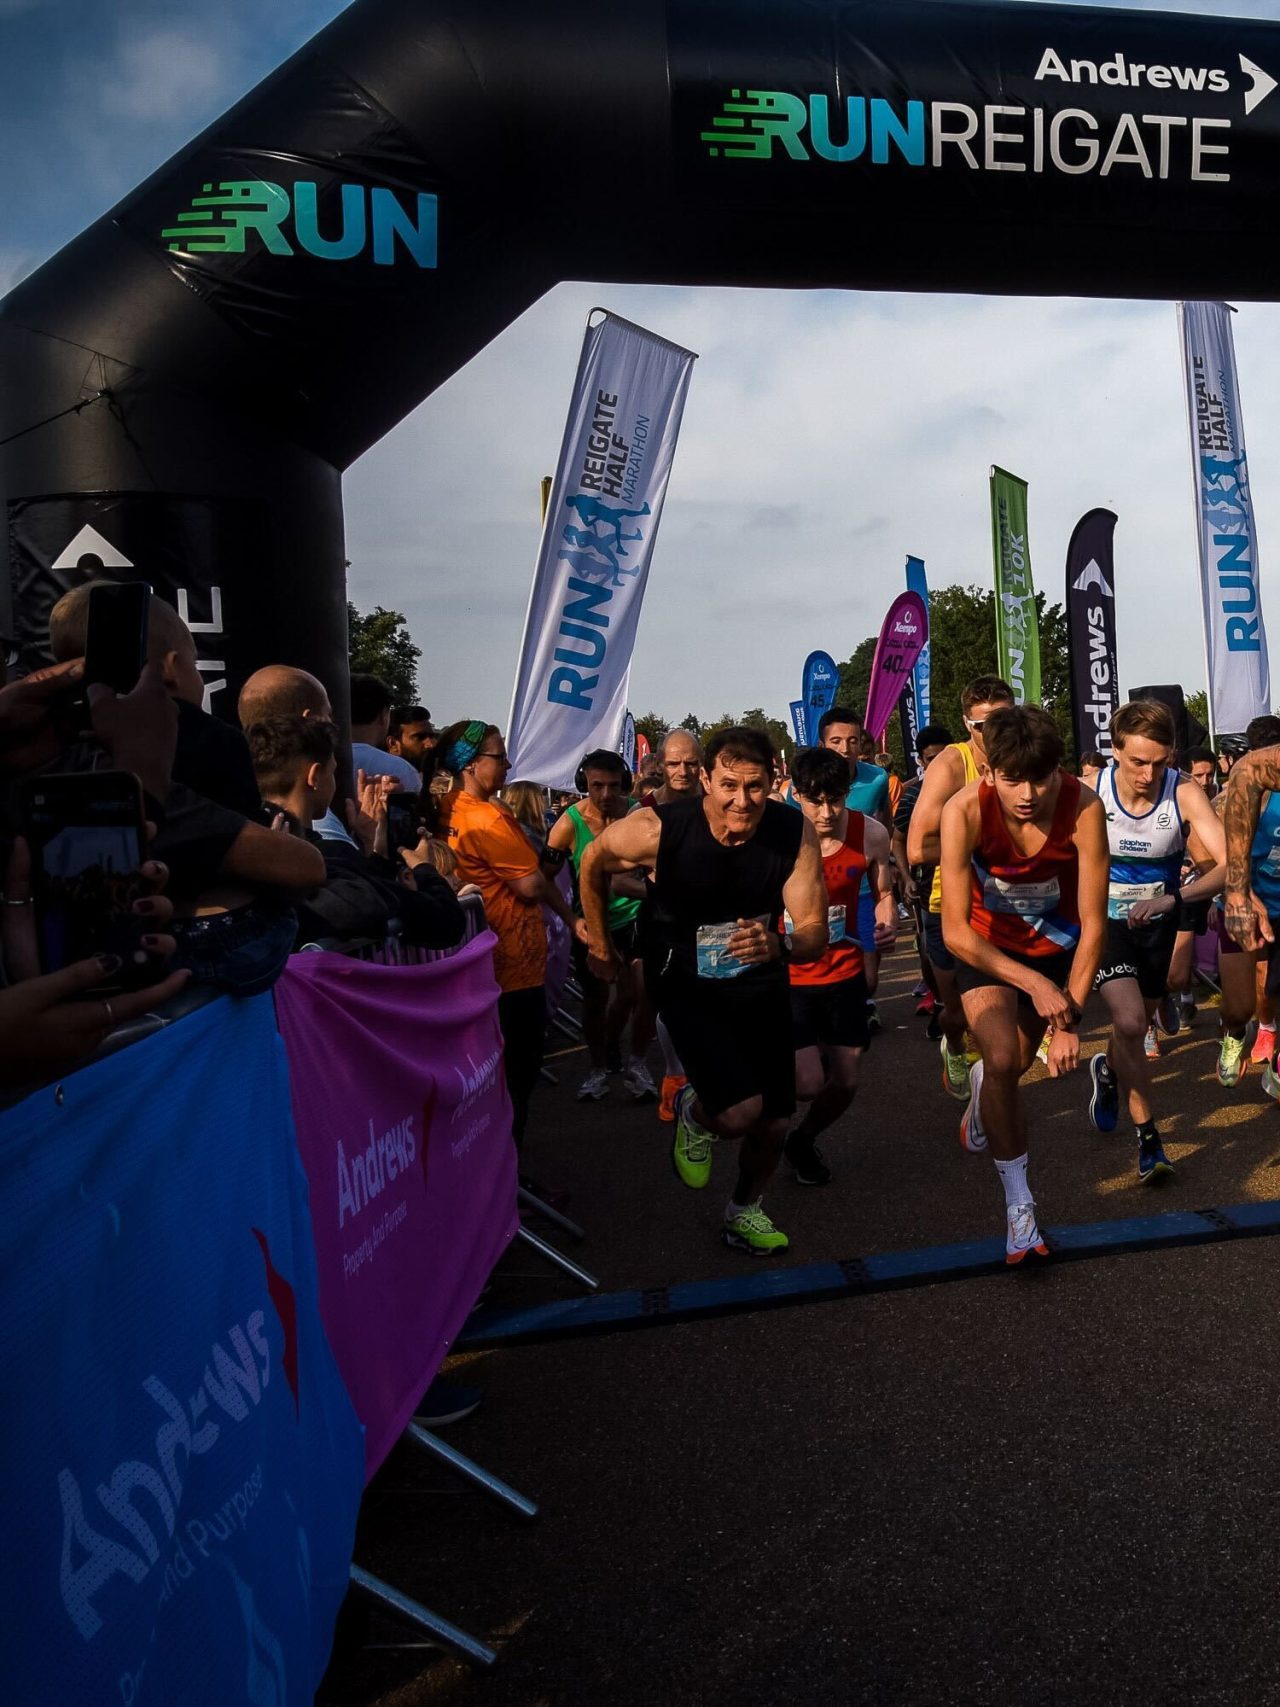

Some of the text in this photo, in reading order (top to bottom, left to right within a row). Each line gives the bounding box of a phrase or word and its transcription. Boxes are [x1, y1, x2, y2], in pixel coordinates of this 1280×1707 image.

[1035, 48, 1230, 92] Andrews
[162, 181, 437, 269] RUN
[580, 390, 618, 490] REIGATE
[1207, 393, 1230, 451] HALF
[602, 433, 630, 500] HALF
[621, 415, 650, 504] MARATHON
[1010, 530, 1027, 588] 10K
[1213, 534, 1261, 652] RUN
[548, 576, 613, 711] RUN
[894, 621, 918, 636] Xempo
[882, 655, 905, 673] 40
[1008, 648, 1025, 705] UN
[1084, 606, 1115, 767] ndrews
[1119, 839, 1152, 848] clapham
[336, 1114, 416, 1230] Andrews
